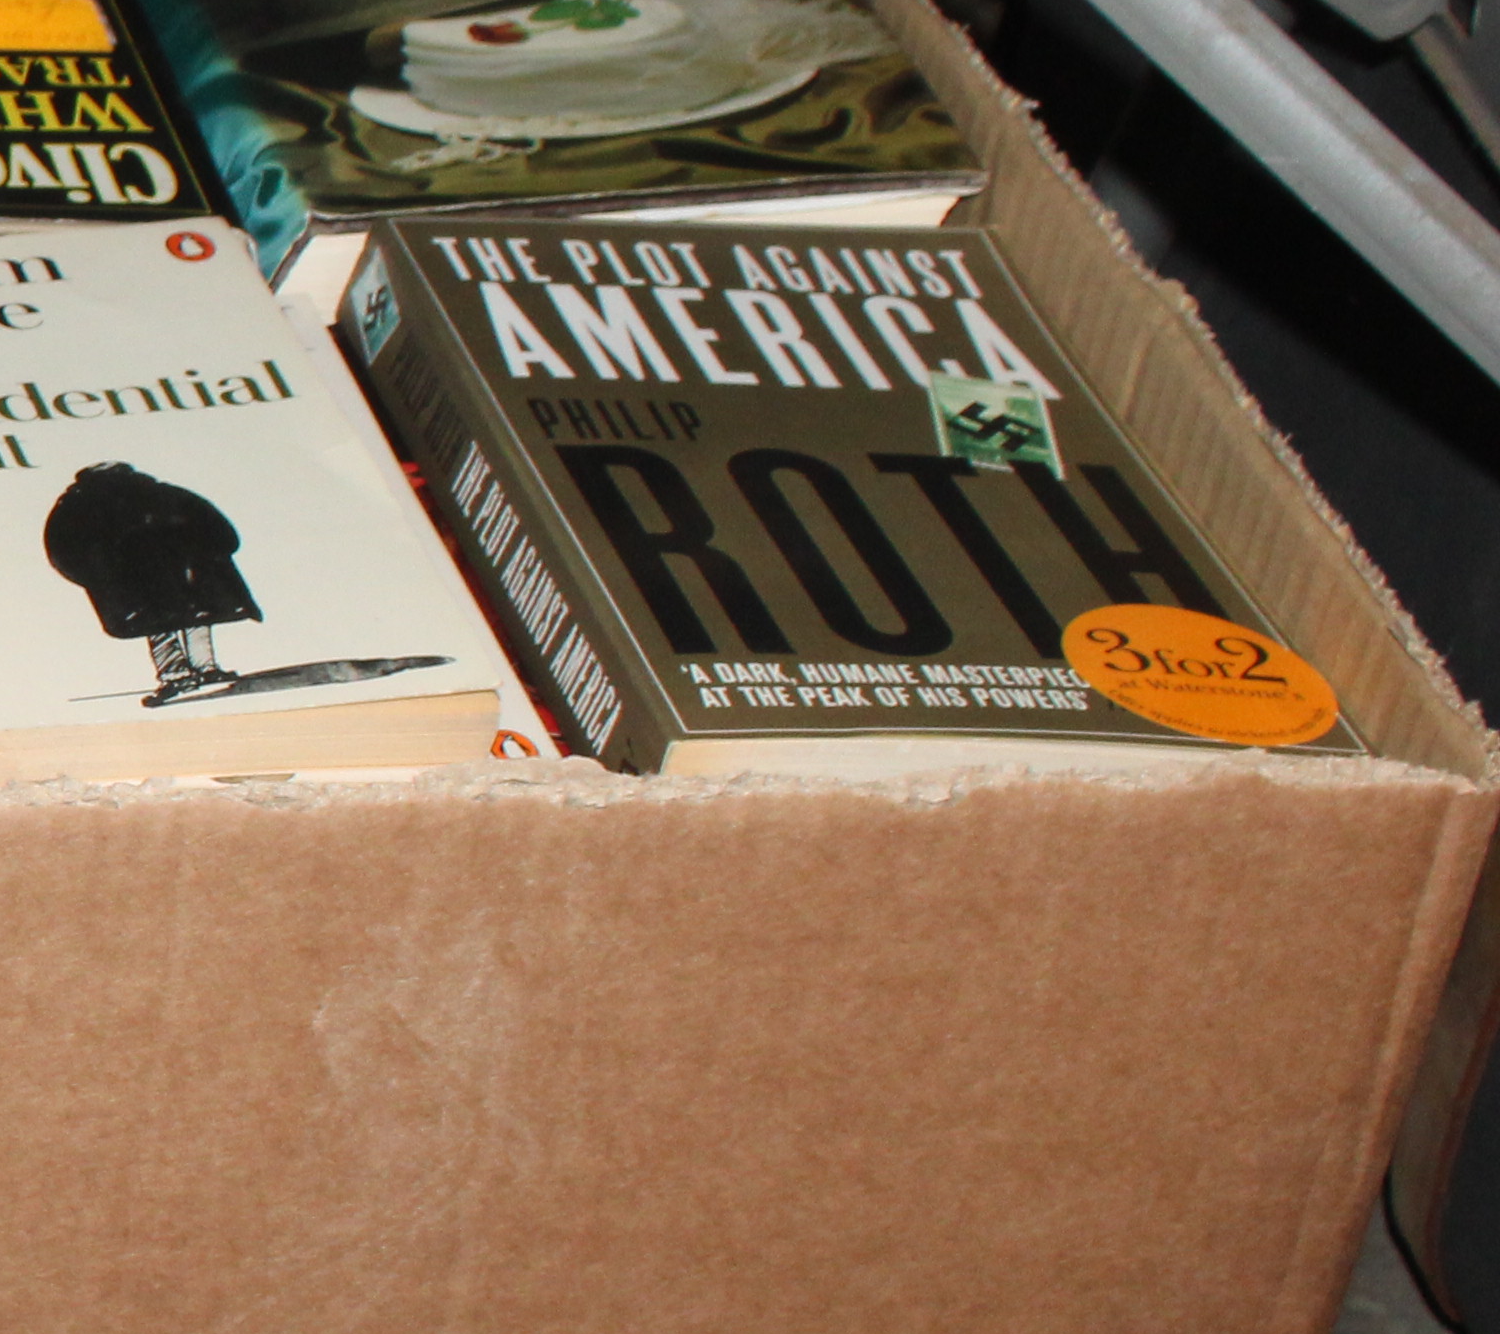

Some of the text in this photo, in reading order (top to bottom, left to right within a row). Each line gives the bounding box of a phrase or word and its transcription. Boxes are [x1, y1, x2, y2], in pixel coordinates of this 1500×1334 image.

[431, 236, 984, 302] THE PLOT AGAINST
[476, 280, 1063, 401] AMERICA
[529, 397, 701, 442] PHILIP
[553, 443, 1238, 662] ROTH
[452, 440, 622, 755] THE PLOT AGAINST AMERICA
[700, 687, 734, 708] AT
[739, 687, 790, 708] THE
[798, 687, 873, 709] PEAK
[875, 688, 910, 708] OF
[917, 688, 968, 709] HIS
[713, 663, 1090, 689] DARK, HUMANE MASTERPIEC
